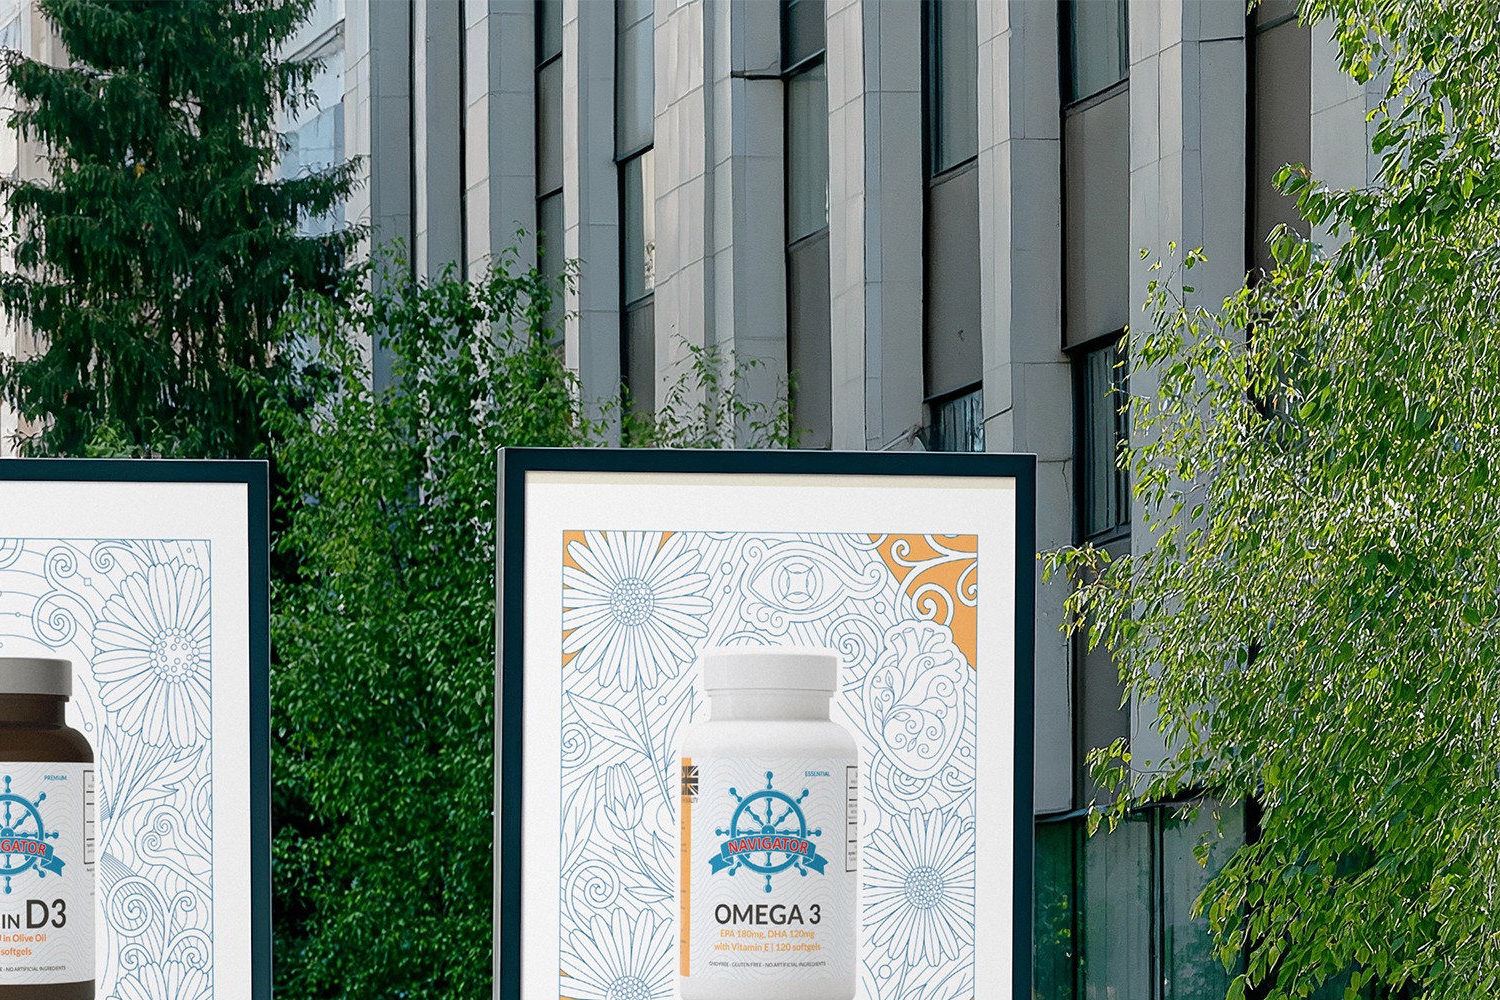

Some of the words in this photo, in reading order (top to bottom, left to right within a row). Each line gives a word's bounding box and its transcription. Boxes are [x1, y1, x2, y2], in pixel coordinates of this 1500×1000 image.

[728, 837, 808, 855] NAVIGATOR
[26, 898, 66, 929] D3
[714, 903, 804, 925] OMEGA
[809, 903, 821, 925] 3
[3, 934, 11, 943] in
[12, 934, 34, 943] Olive
[35, 934, 46, 943] Oil
[720, 929, 735, 938] EPA
[767, 929, 787, 938] DHA
[789, 929, 815, 939] 120mg
[0, 947, 32, 958] softgels
[714, 943, 730, 951] with
[731, 943, 763, 952] Vitamin
[764, 943, 769, 952] E
[776, 943, 791, 952] 120
[792, 942, 821, 952] softgels
